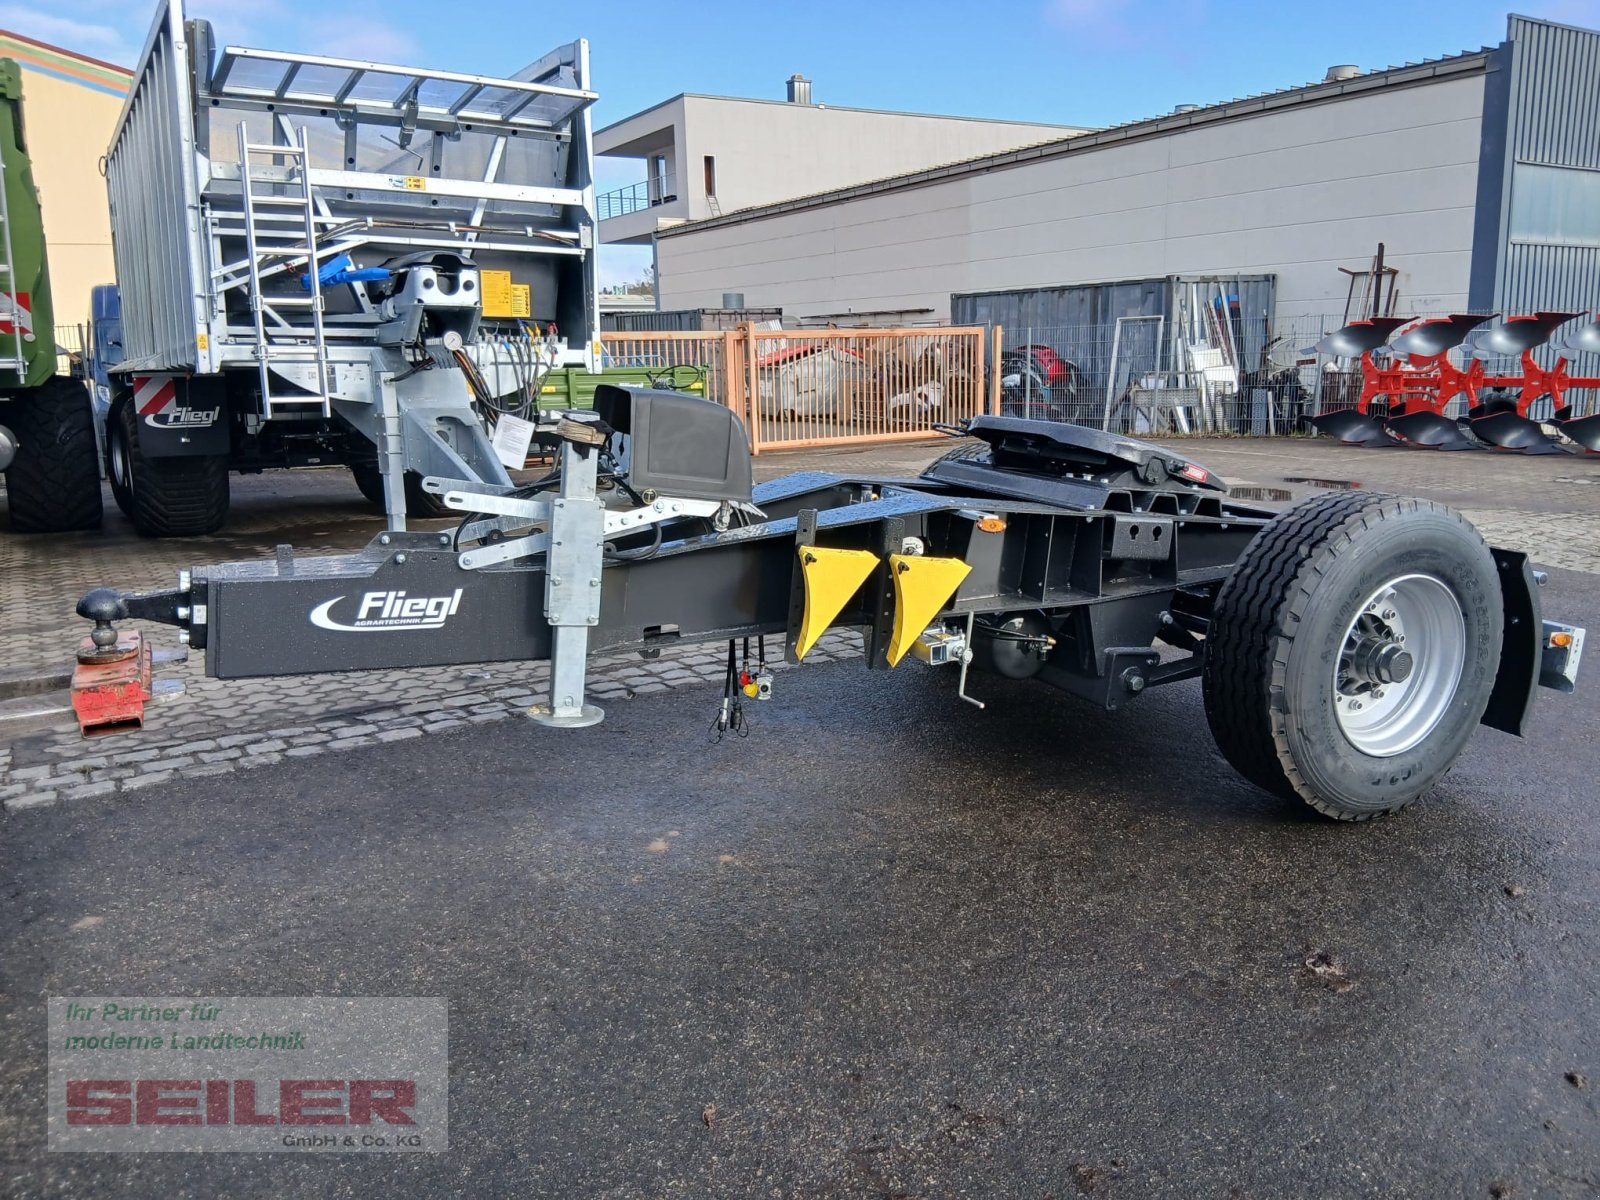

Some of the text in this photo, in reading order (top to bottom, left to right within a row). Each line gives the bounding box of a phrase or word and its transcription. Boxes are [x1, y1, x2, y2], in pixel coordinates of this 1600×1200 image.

[168, 406, 220, 424] Fliegl
[357, 588, 464, 622] Fliegl
[354, 618, 422, 627] AGRARTECHNIK
